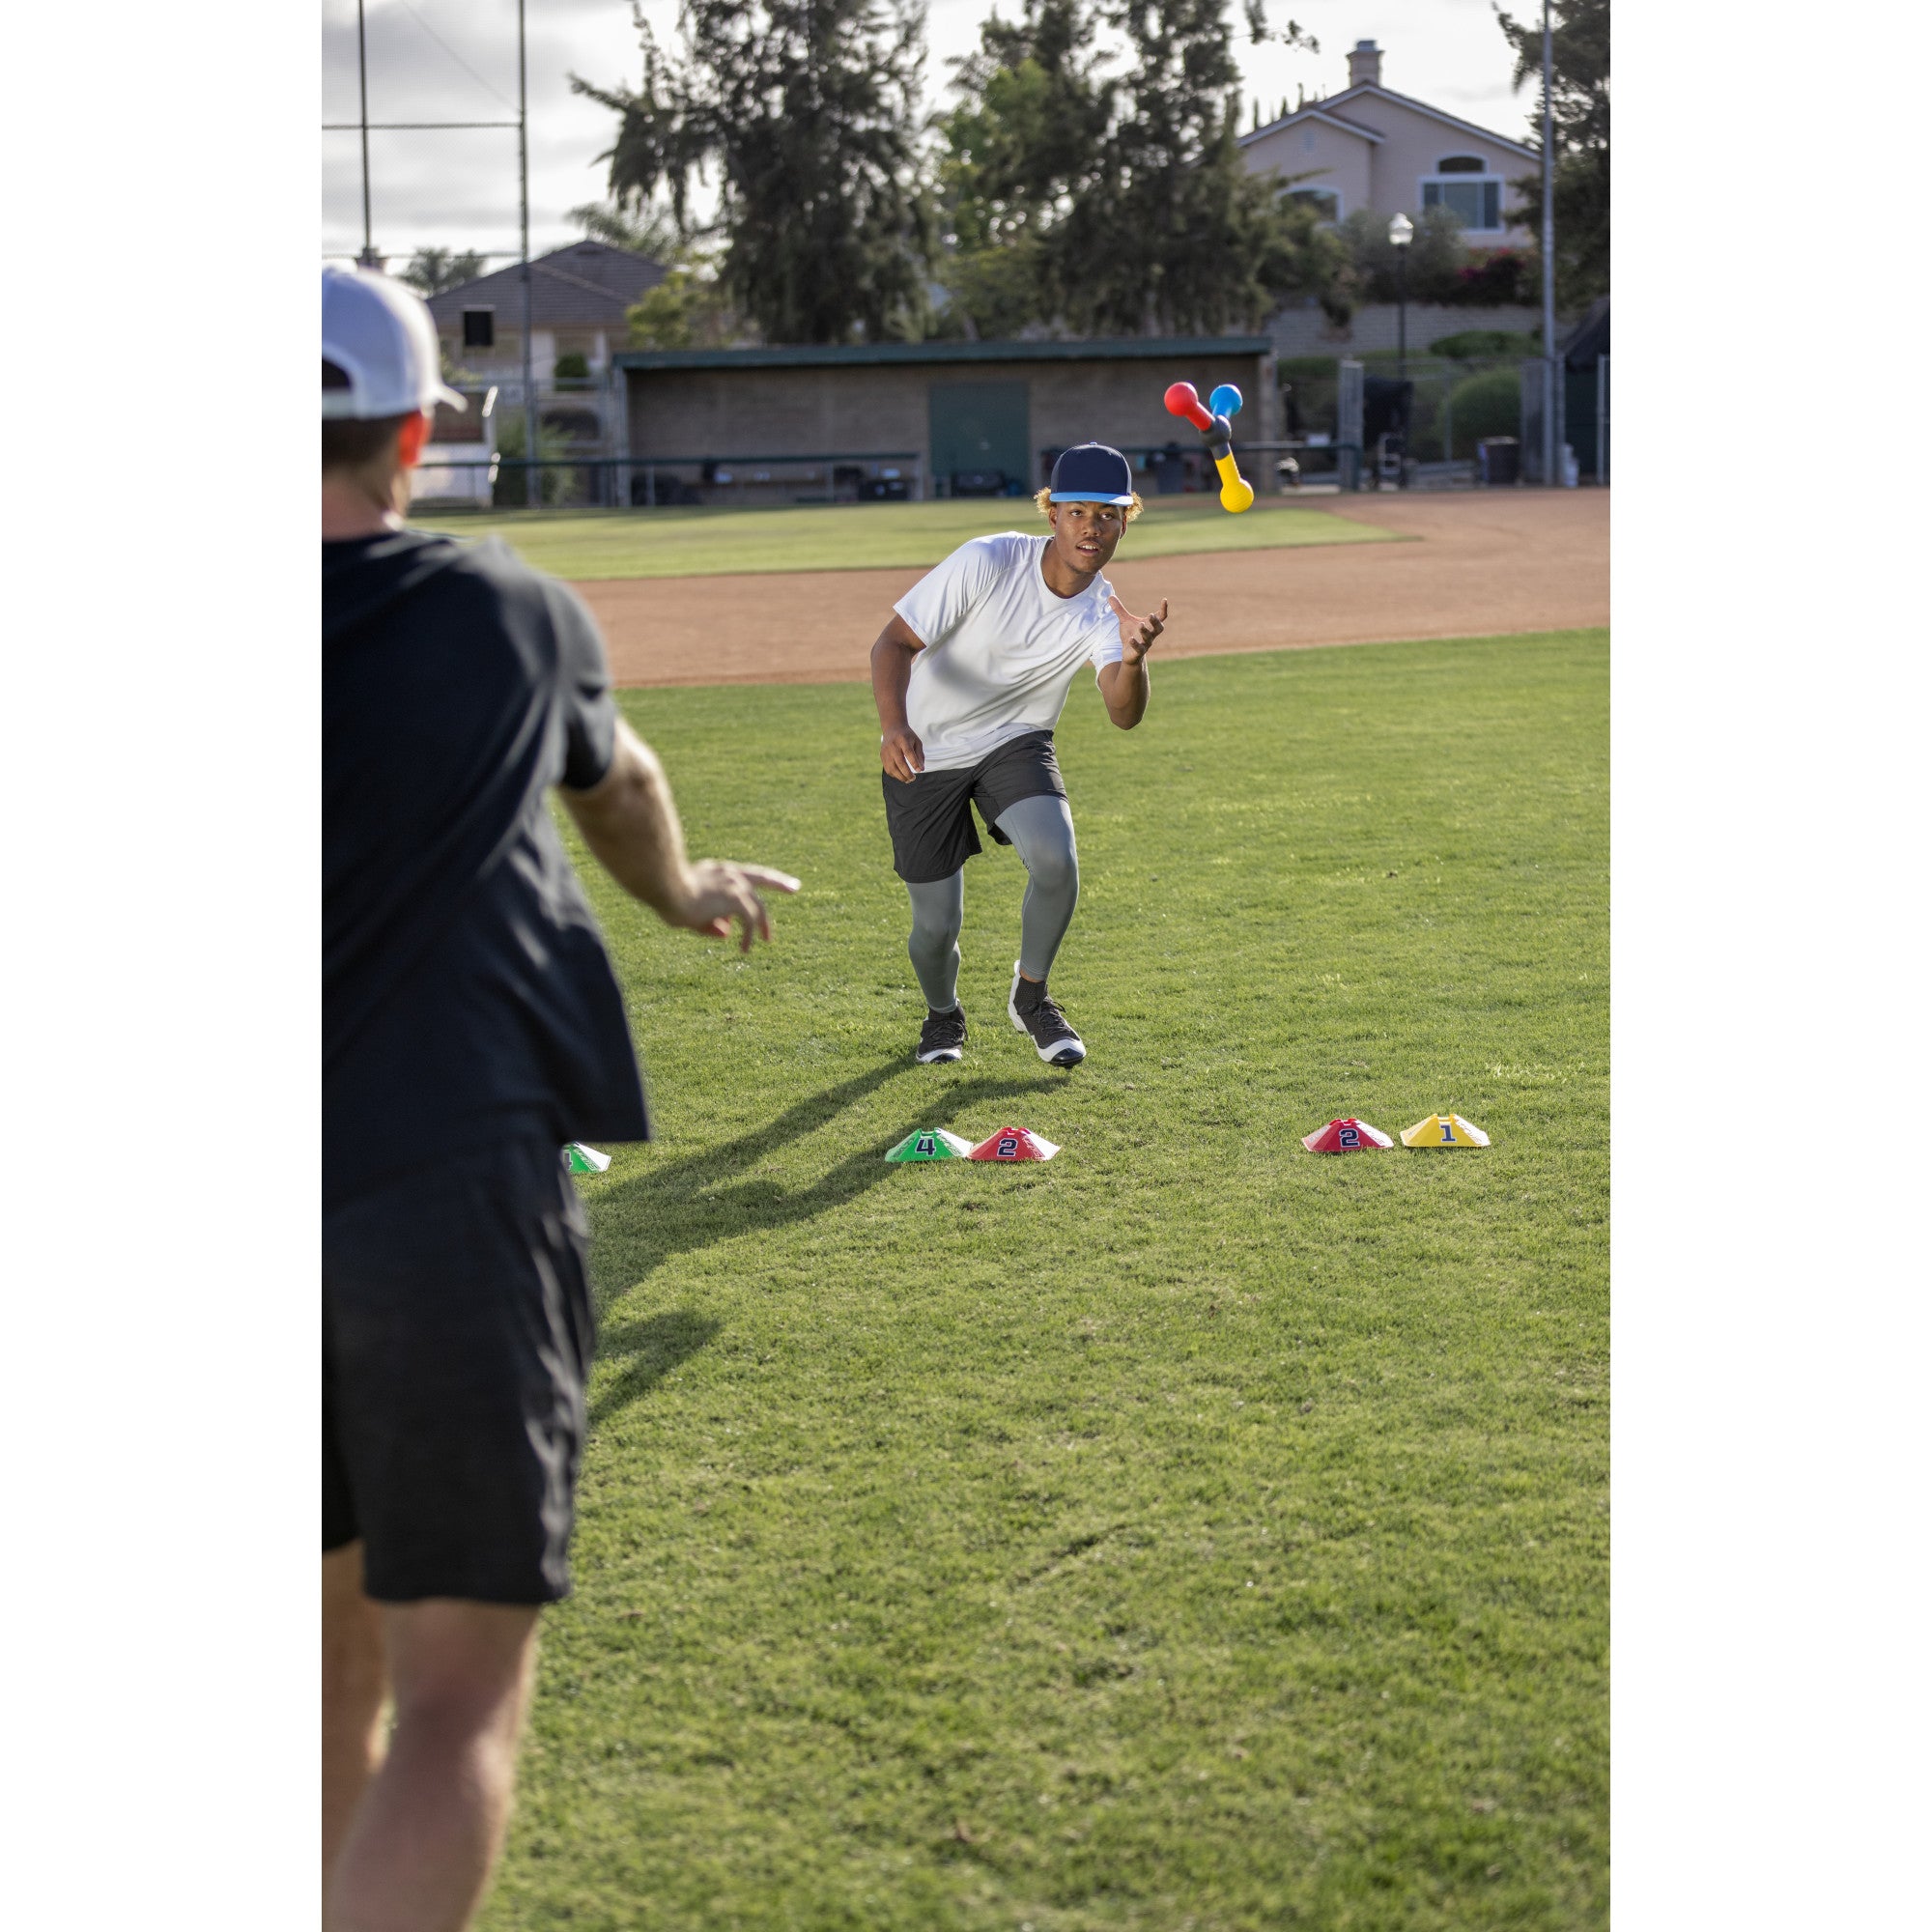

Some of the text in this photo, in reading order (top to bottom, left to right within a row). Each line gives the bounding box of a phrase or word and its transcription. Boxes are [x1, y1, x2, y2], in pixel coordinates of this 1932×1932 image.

[1339, 1128, 1360, 1148] 2
[1439, 1124, 1457, 1143] 1
[915, 1138, 937, 1156] 4
[997, 1138, 1018, 1156] 2
